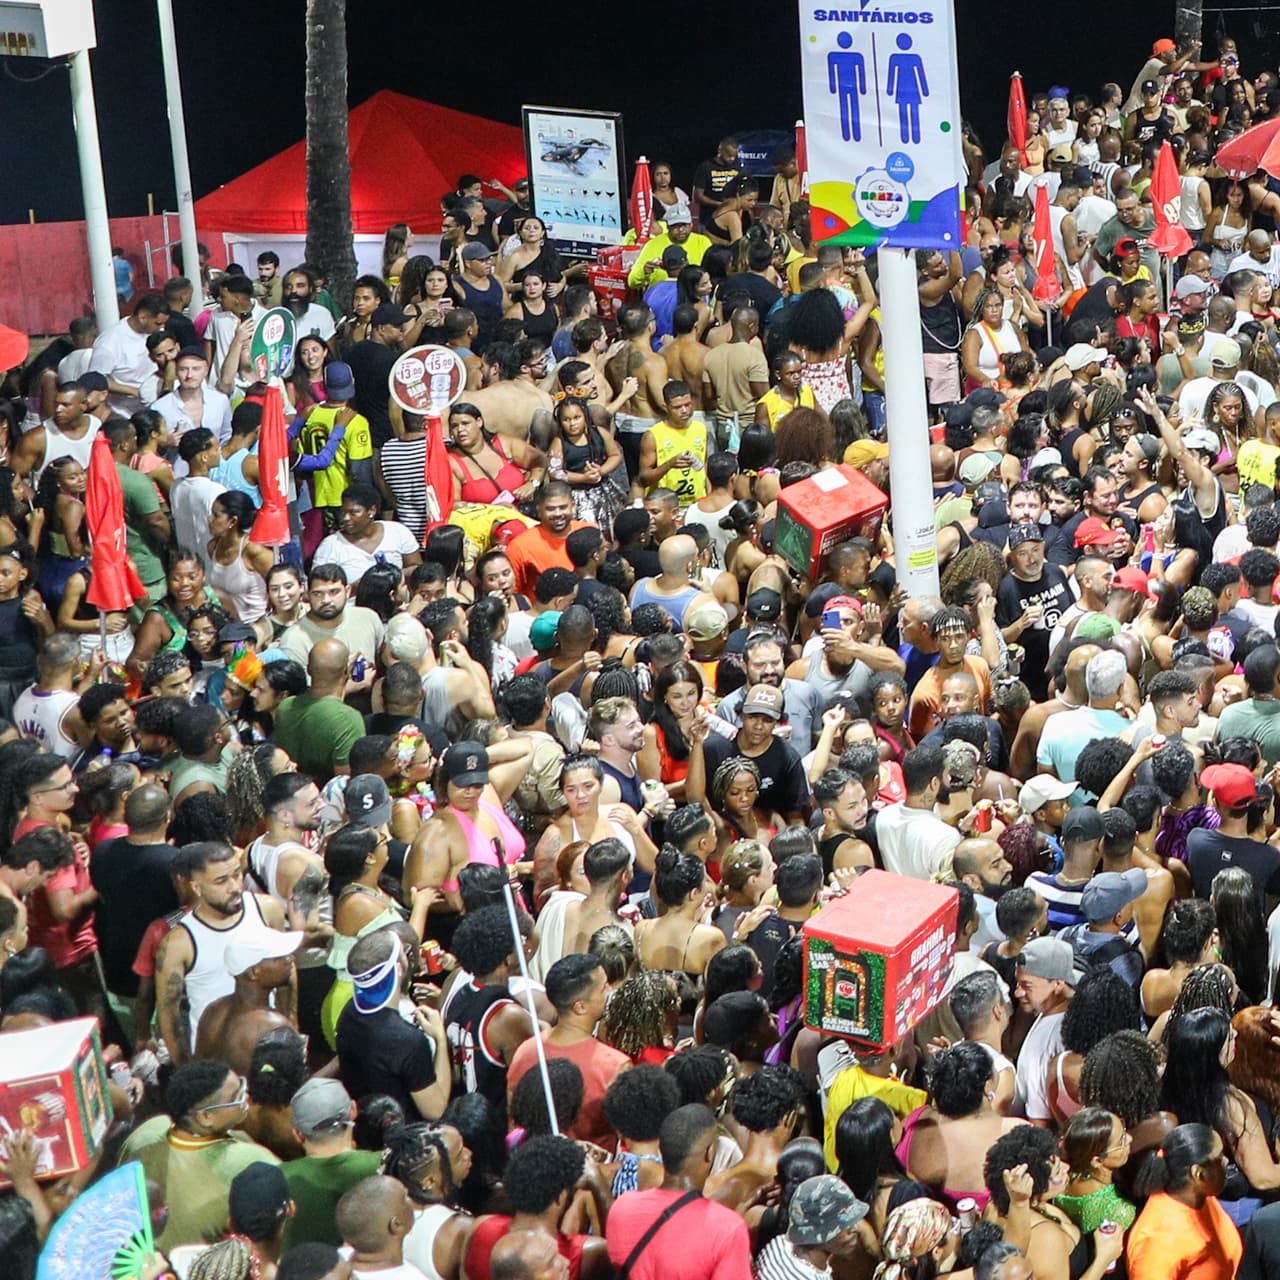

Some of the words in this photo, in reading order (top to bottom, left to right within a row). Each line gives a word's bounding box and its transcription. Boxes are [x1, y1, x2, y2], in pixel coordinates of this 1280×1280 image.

[813, 6, 934, 25] SANITÁRIOS
[1020, 582, 1065, 610] BMAIN
[362, 793, 374, 810] S
[910, 926, 945, 967] BRAHMA
